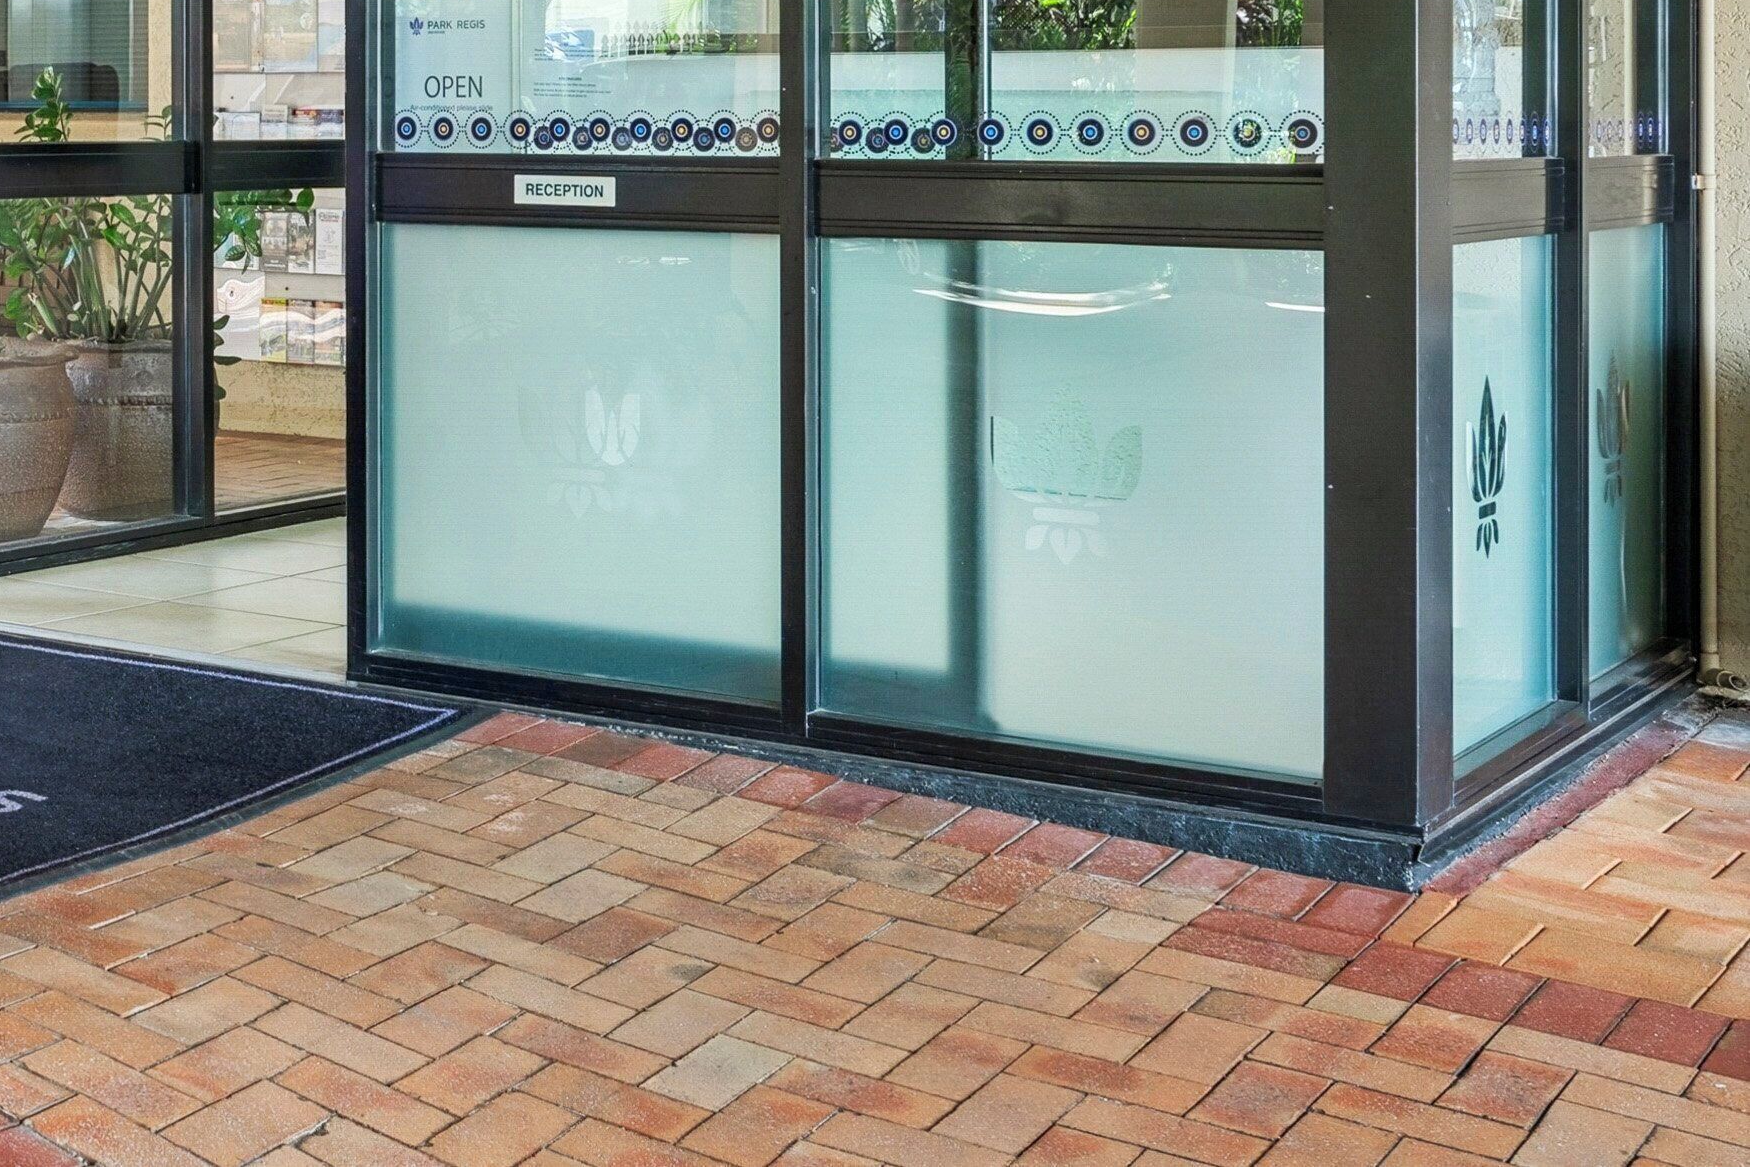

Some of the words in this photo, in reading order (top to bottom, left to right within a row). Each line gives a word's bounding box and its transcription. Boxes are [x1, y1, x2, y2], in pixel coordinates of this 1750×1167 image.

[427, 20, 452, 30] PARK
[456, 20, 486, 29] REGIS
[424, 75, 483, 98] OPEN
[525, 182, 604, 198] RECEPTION
